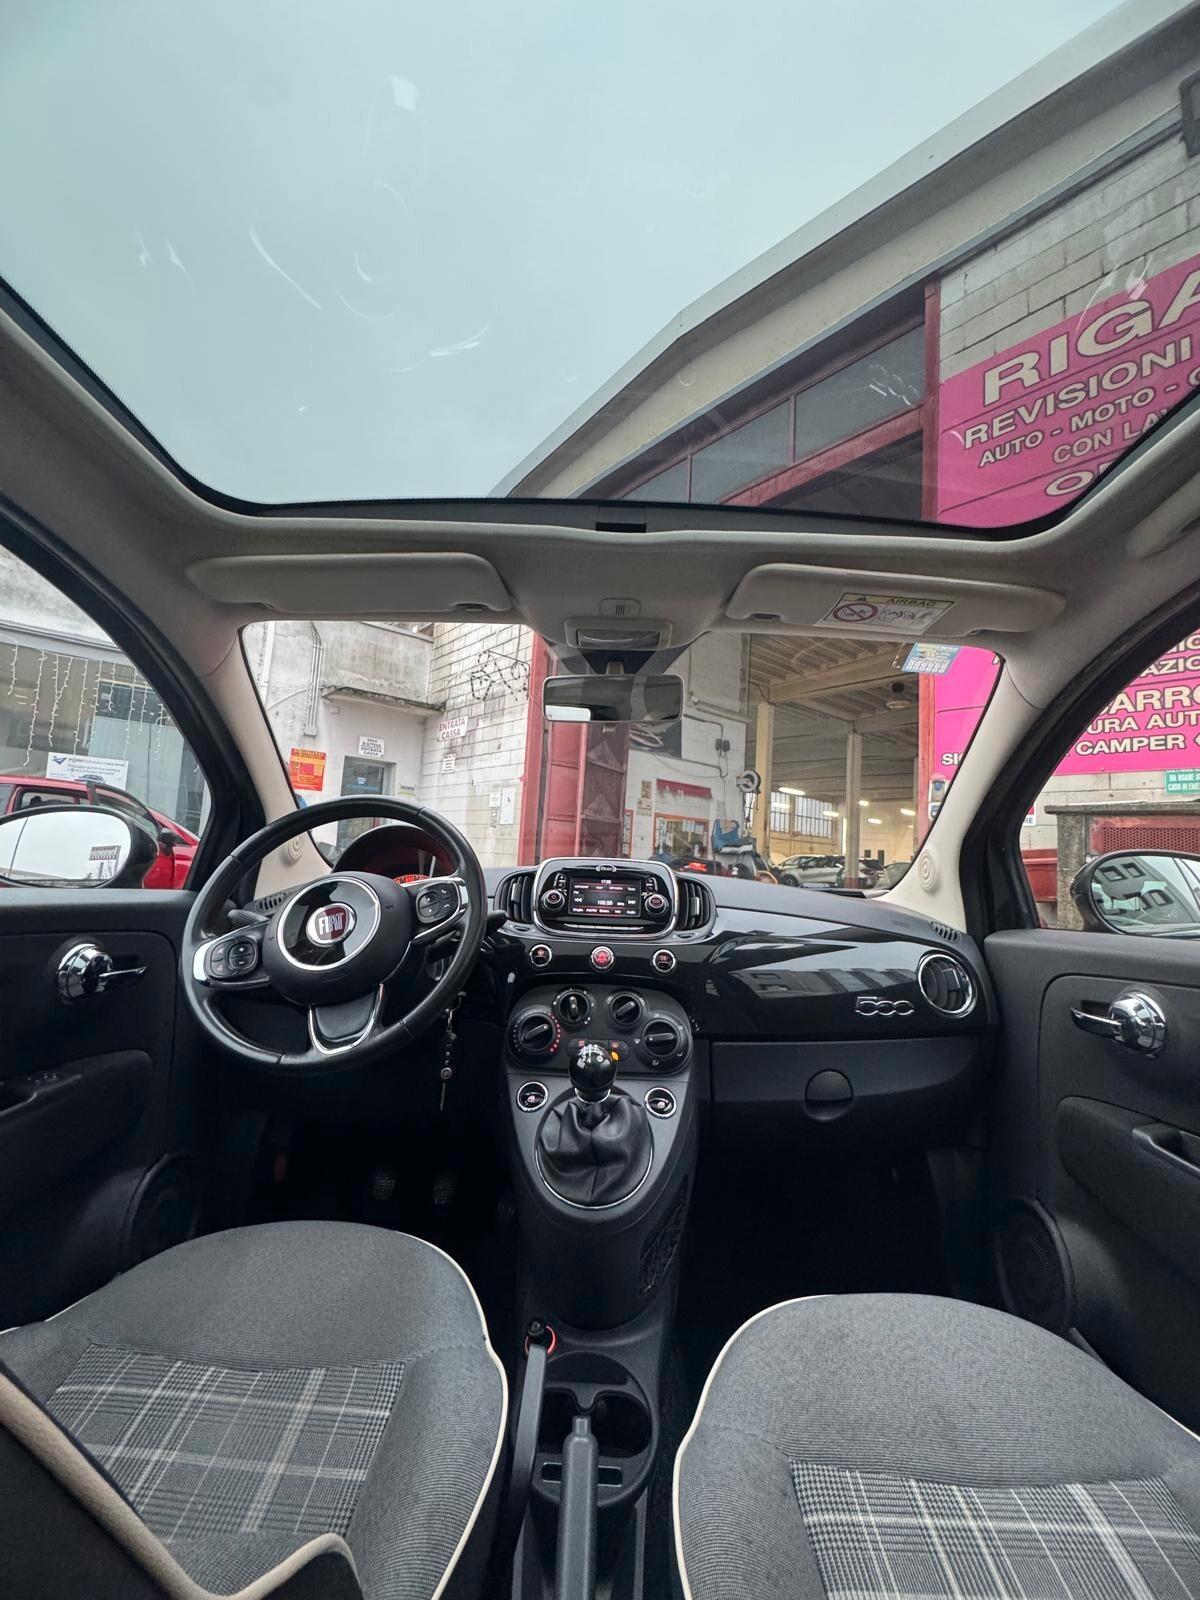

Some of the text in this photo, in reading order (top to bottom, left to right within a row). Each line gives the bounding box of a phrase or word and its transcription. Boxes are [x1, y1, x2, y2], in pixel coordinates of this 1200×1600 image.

[964, 335, 1191, 449] REVISIONI
[979, 431, 1043, 468] AUTO
[1070, 387, 1155, 432] MOTO
[1053, 408, 1169, 465] CON LA
[886, 597, 937, 608] AIRBAG
[1100, 684, 1200, 716] ARR
[439, 717, 466, 732] ENTRATA
[441, 728, 461, 740] CASSA
[1086, 716, 1139, 735] URA
[1075, 733, 1187, 756] CAMPER
[318, 912, 345, 935] FIAT
[855, 996, 915, 1016] 500
